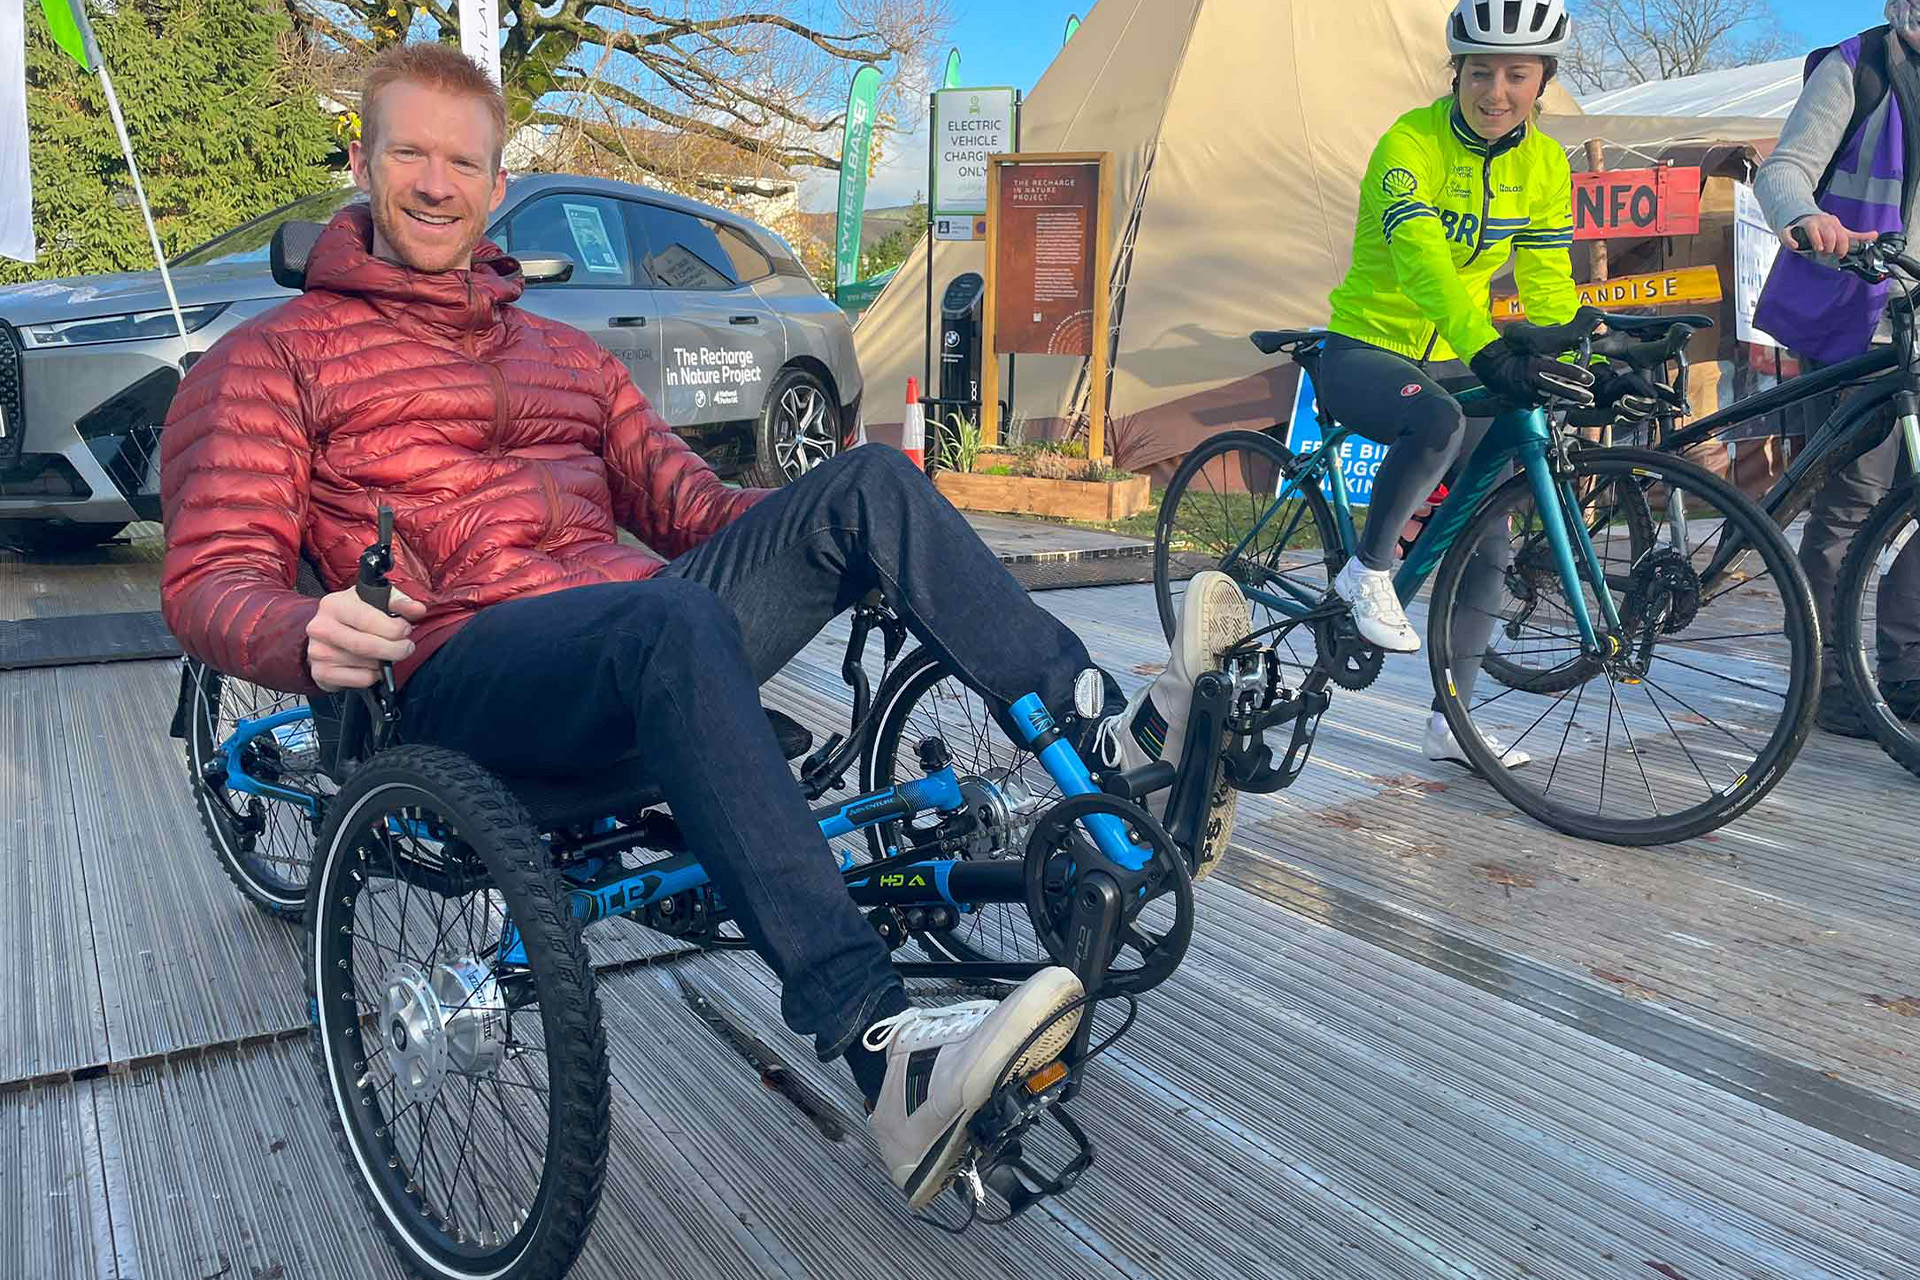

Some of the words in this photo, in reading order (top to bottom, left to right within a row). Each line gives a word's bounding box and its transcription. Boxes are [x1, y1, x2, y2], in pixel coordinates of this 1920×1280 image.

[948, 119, 1002, 132] ELECTRIC
[950, 135, 998, 147] VEHICLE
[944, 150, 1003, 162] CHARGI
[958, 166, 987, 177] ONLY
[1032, 179, 1076, 188] RECHARGE
[1025, 186, 1056, 194] NATURE
[1571, 180, 1658, 230] NFO
[1508, 277, 1679, 315] MANDISE
[673, 347, 698, 366] The
[700, 346, 754, 368] Recharge
[666, 367, 678, 386] in
[681, 366, 721, 386] Nature
[722, 365, 762, 387] Project
